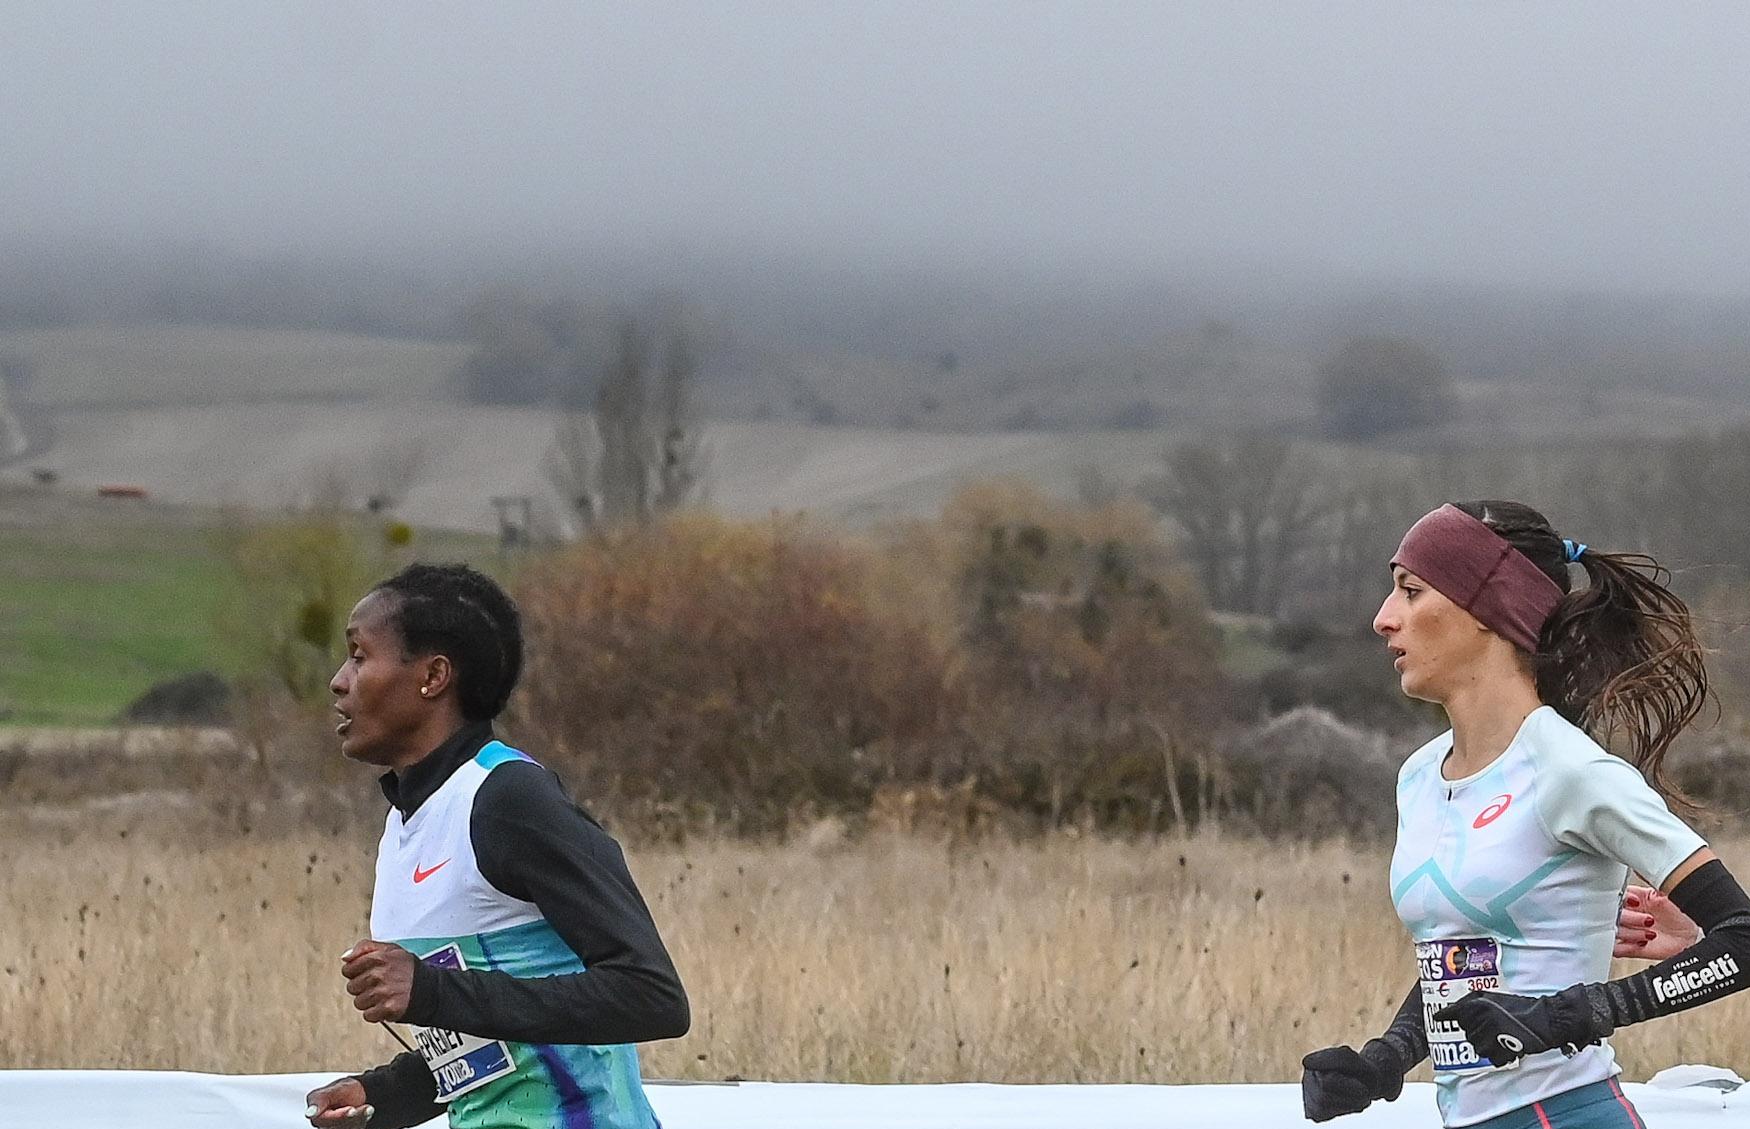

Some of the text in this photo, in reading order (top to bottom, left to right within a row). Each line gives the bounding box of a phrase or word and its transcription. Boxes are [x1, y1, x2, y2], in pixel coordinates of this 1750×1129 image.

[1673, 956, 1699, 970] ITALIA
[1468, 977, 1498, 991] 3602
[1652, 953, 1740, 1003] felicetti
